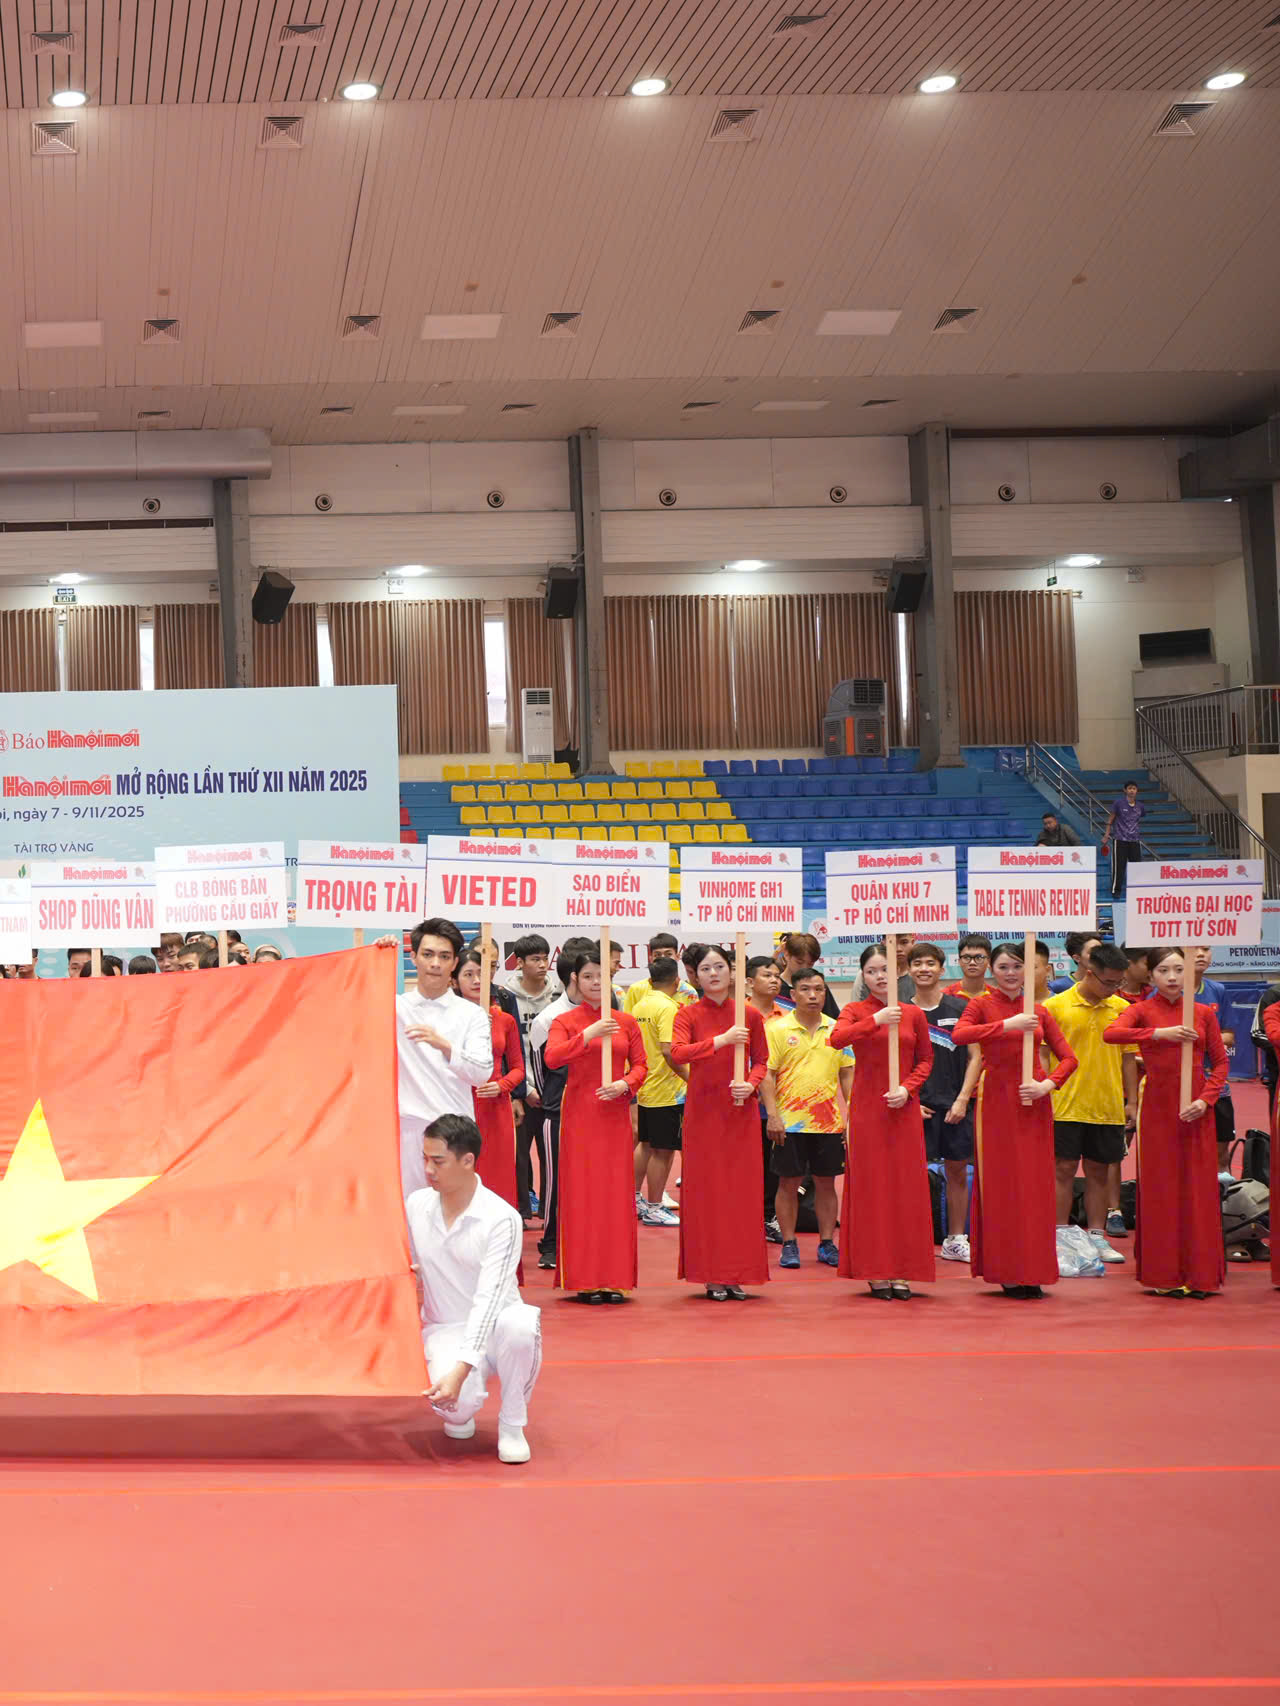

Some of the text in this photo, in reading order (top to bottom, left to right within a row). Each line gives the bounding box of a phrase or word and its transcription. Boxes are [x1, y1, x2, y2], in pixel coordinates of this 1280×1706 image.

[12, 733, 45, 749] Báo
[116, 767, 142, 795] MỞ
[146, 769, 189, 799] RỘNG
[193, 765, 223, 794] LẦN
[228, 767, 259, 793] THỨ
[263, 771, 283, 792] XII
[288, 766, 325, 792] NĂM
[330, 769, 367, 791] 2025
[13, 808, 47, 822] ngày
[51, 808, 60, 819] 7
[72, 805, 145, 819] 9/11/2025
[14, 841, 94, 855] TÀI TRỢ VÀNG
[285, 857, 298, 866] TR
[176, 873, 267, 898] CLB BÓNG BÀN
[442, 874, 537, 908] VIETED
[573, 869, 641, 893] SAO BIỂN
[699, 881, 783, 898] VINHOME GH1
[851, 880, 931, 902] QUÂN KHU 7
[166, 896, 278, 924] PHƯỜNG CẦU GIẤY
[305, 875, 417, 921] TRỌNG TÀI
[566, 892, 647, 918] HẢI DƯƠNG
[974, 888, 1090, 916] TABLE TENNIS REVIEW
[1136, 892, 1253, 916] TRƯỜNG ĐẠI HỌC
[39, 892, 154, 930] SHOP DŨNG VÂN
[698, 905, 712, 922] TP
[716, 899, 733, 922] HỒ
[737, 901, 758, 922] CHÍ
[762, 905, 795, 922] MINH
[844, 908, 861, 925] TP
[864, 901, 882, 924] HỒ
[886, 904, 909, 923] CHÍ
[913, 904, 949, 922] MINH
[1150, 916, 1237, 938] TDTT TỪ SƠN
[1229, 947, 1280, 956] PETROVIETNA
